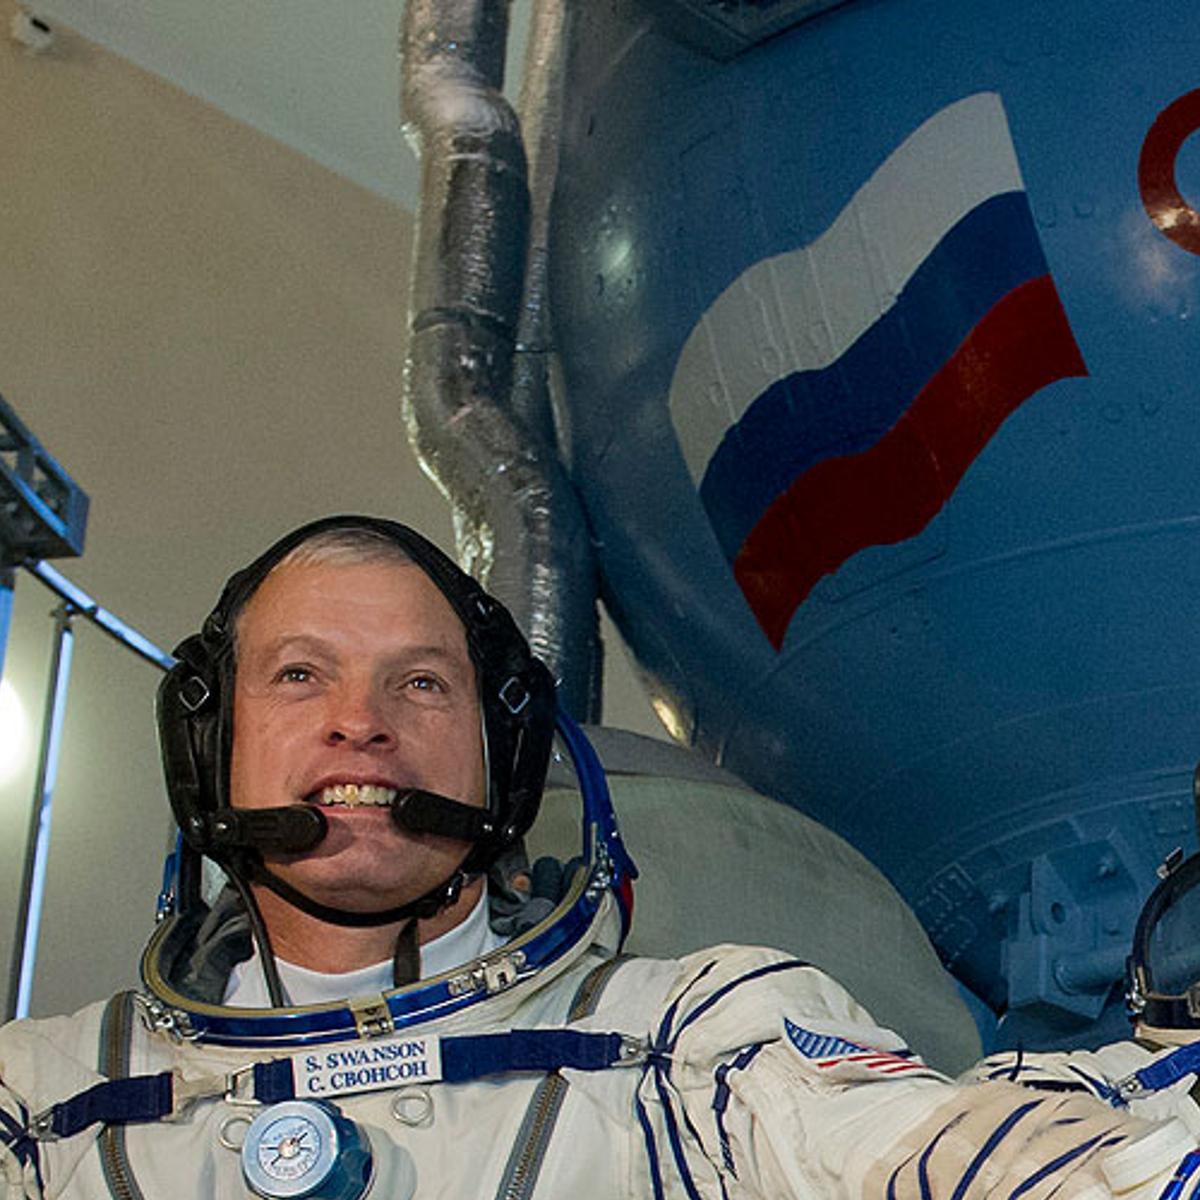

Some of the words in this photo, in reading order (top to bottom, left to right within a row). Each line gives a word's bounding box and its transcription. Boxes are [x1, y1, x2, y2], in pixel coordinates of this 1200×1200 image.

[306, 1056, 322, 1073] S.
[327, 1041, 426, 1069] SWANSON
[308, 1076, 325, 1093] С.
[331, 1061, 428, 1090] СВОНСОН
